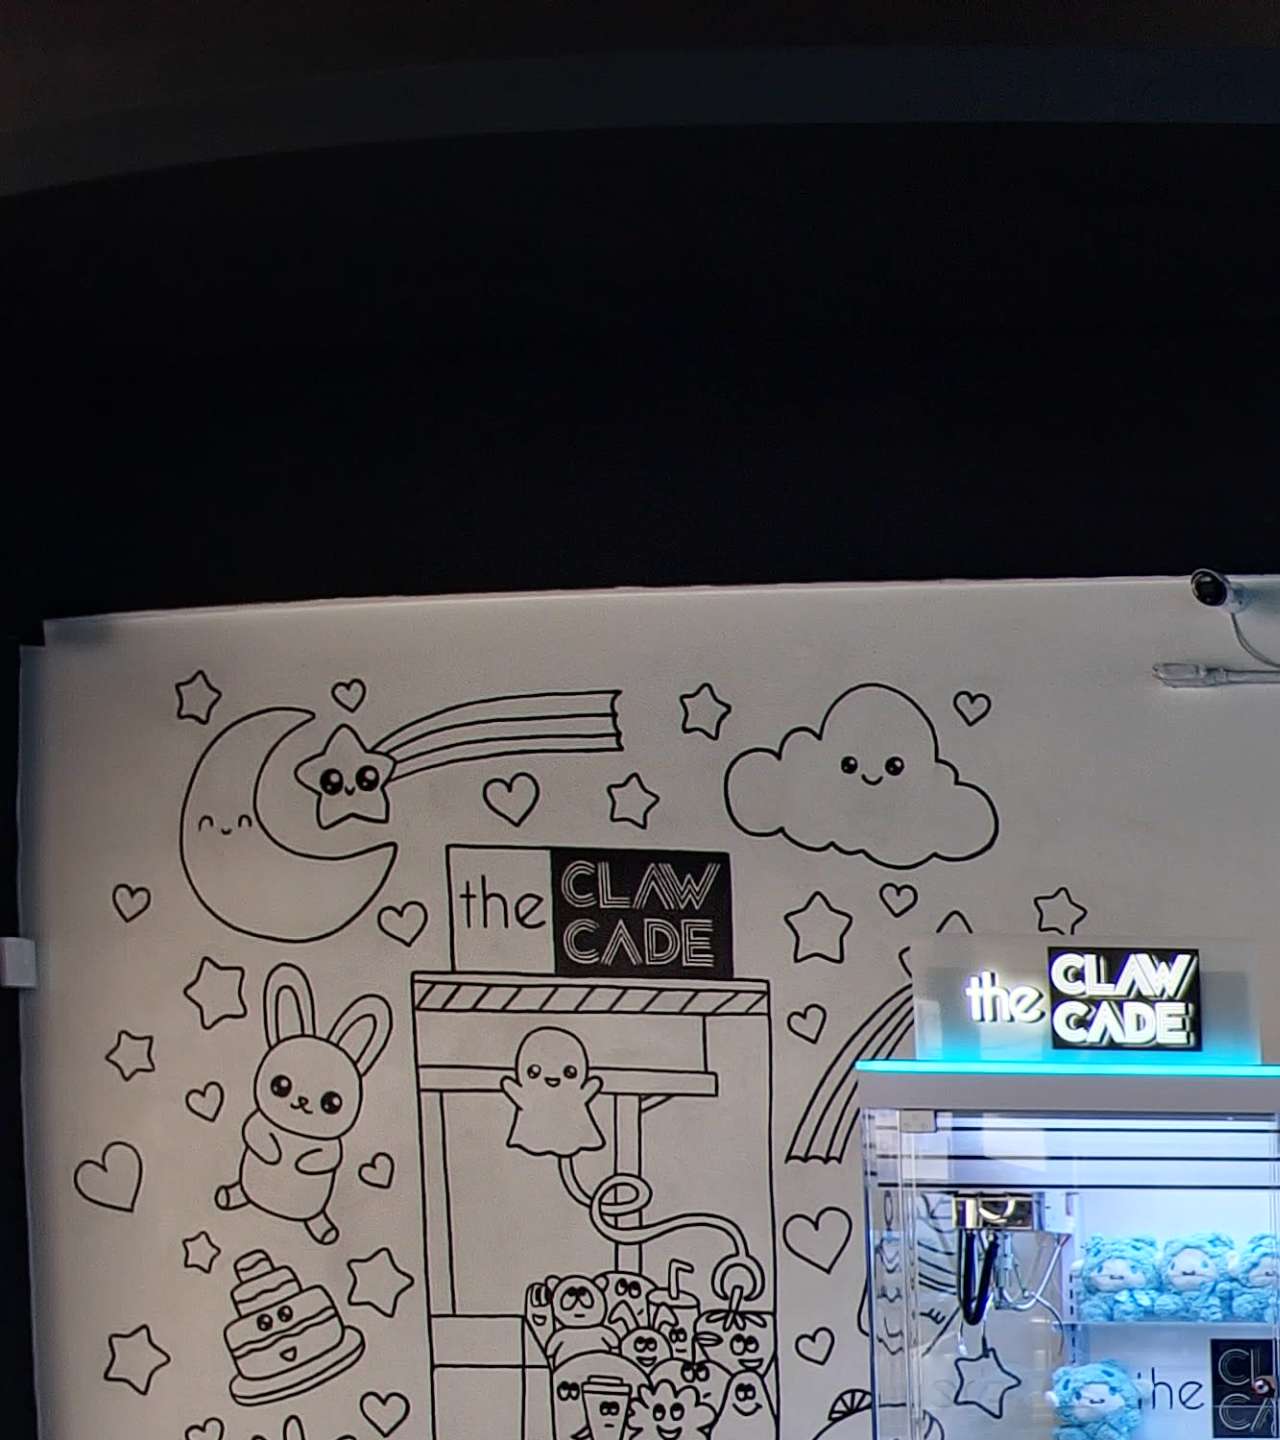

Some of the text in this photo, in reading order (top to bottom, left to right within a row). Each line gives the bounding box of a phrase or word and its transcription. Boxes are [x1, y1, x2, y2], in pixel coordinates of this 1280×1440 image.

[460, 861, 720, 929] the CLAW
[563, 919, 714, 967] CADE
[966, 953, 1194, 1023] the CLAW
[1053, 1001, 1193, 1045] CADE
